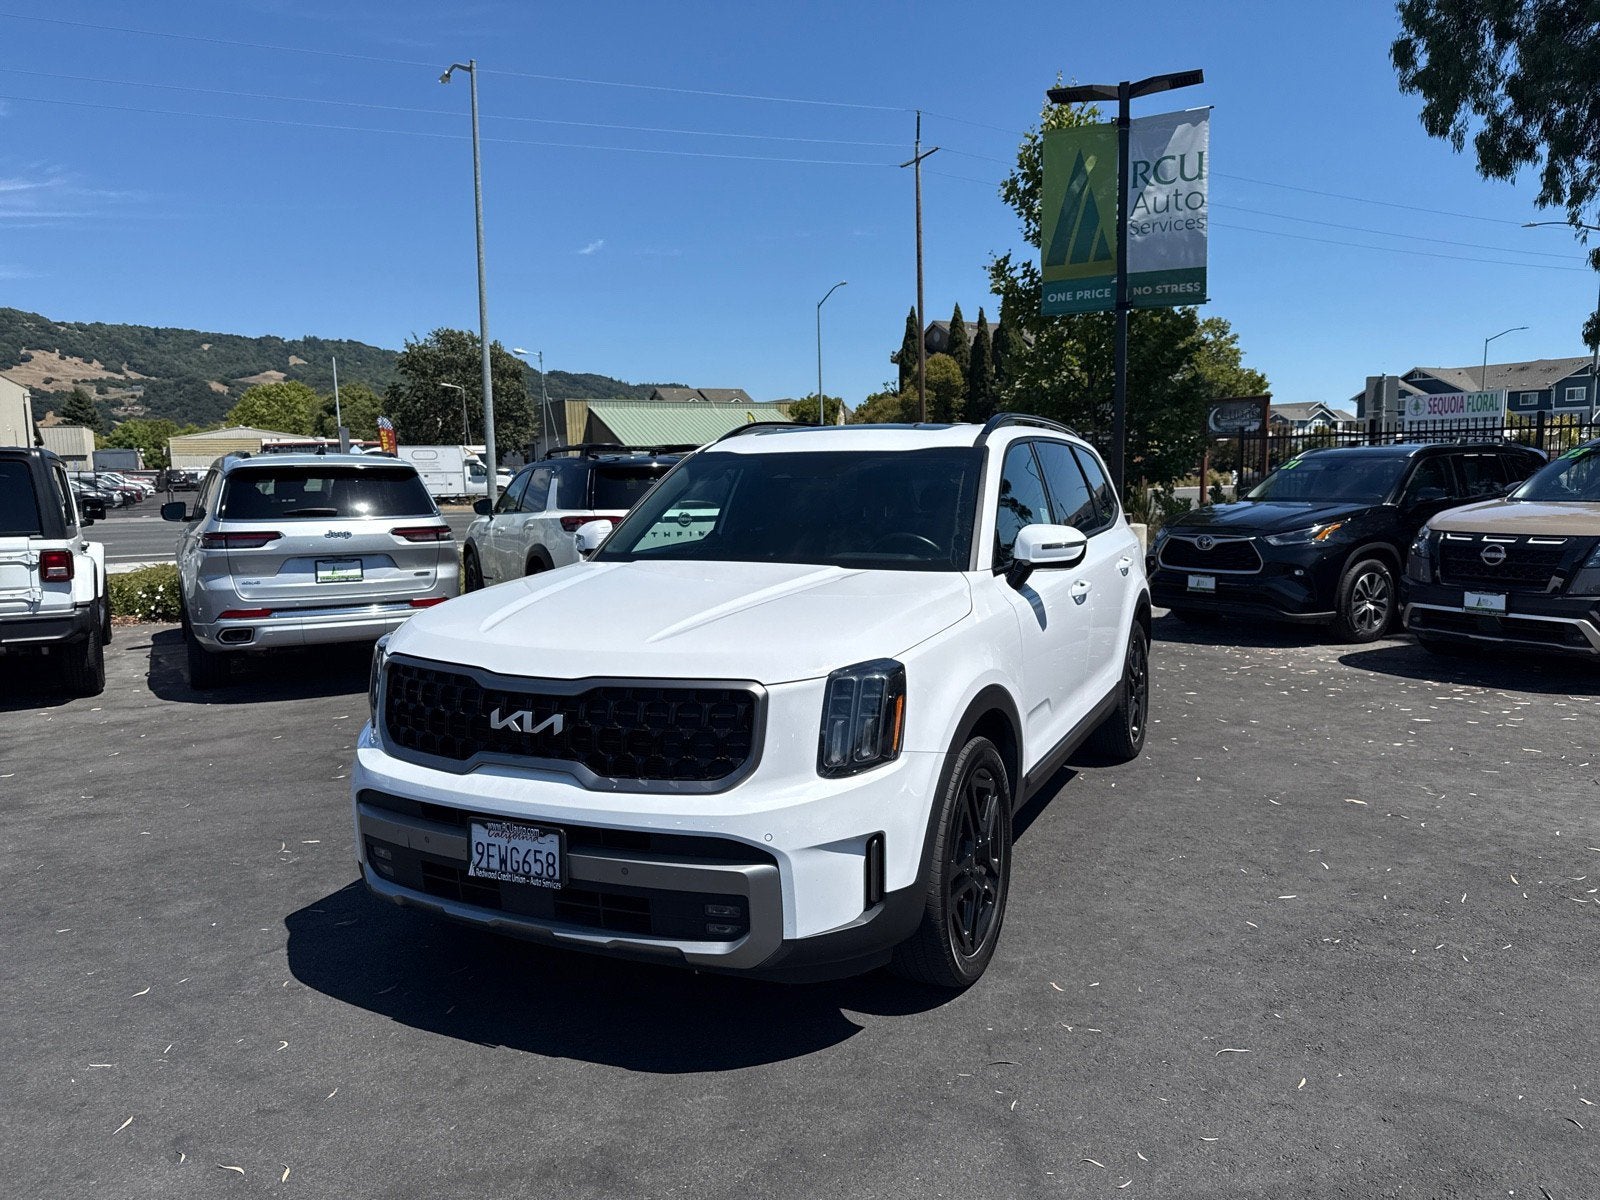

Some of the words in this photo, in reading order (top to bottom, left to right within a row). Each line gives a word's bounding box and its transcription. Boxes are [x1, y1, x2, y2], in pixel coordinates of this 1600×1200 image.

[1132, 151, 1205, 189] RCU
[1131, 188, 1205, 217] Auto
[1130, 215, 1205, 236] Services
[1047, 291, 1073, 303] ONE
[1076, 288, 1111, 300] PRICE
[1133, 284, 1152, 296] NO
[1155, 282, 1201, 293] STRESS
[1428, 396, 1465, 415] SEQUOIA
[1467, 393, 1499, 413] FLORAL
[324, 530, 353, 539] Jeep
[490, 707, 564, 736] KIA
[476, 868, 497, 879] Redwood
[497, 871, 511, 882] Credit
[512, 873, 526, 884] Union
[530, 877, 542, 887] Auto
[542, 878, 562, 890] Services
